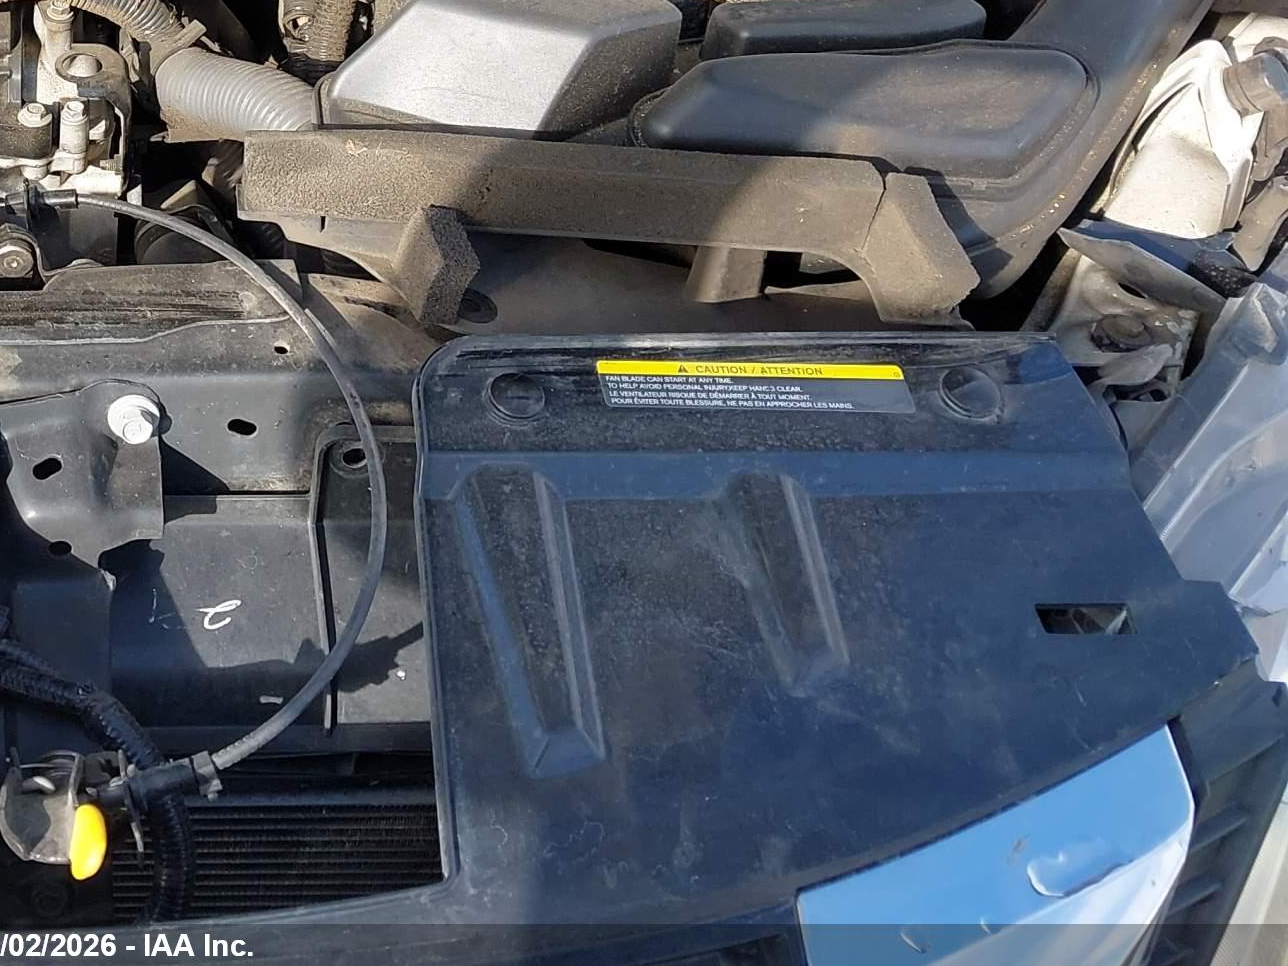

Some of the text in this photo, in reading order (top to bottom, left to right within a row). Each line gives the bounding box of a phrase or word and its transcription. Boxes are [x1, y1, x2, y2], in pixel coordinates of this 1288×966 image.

[695, 365, 747, 374] CAUTION
[760, 366, 823, 376] ATTENTION
[634, 397, 659, 405] ÉVITER
